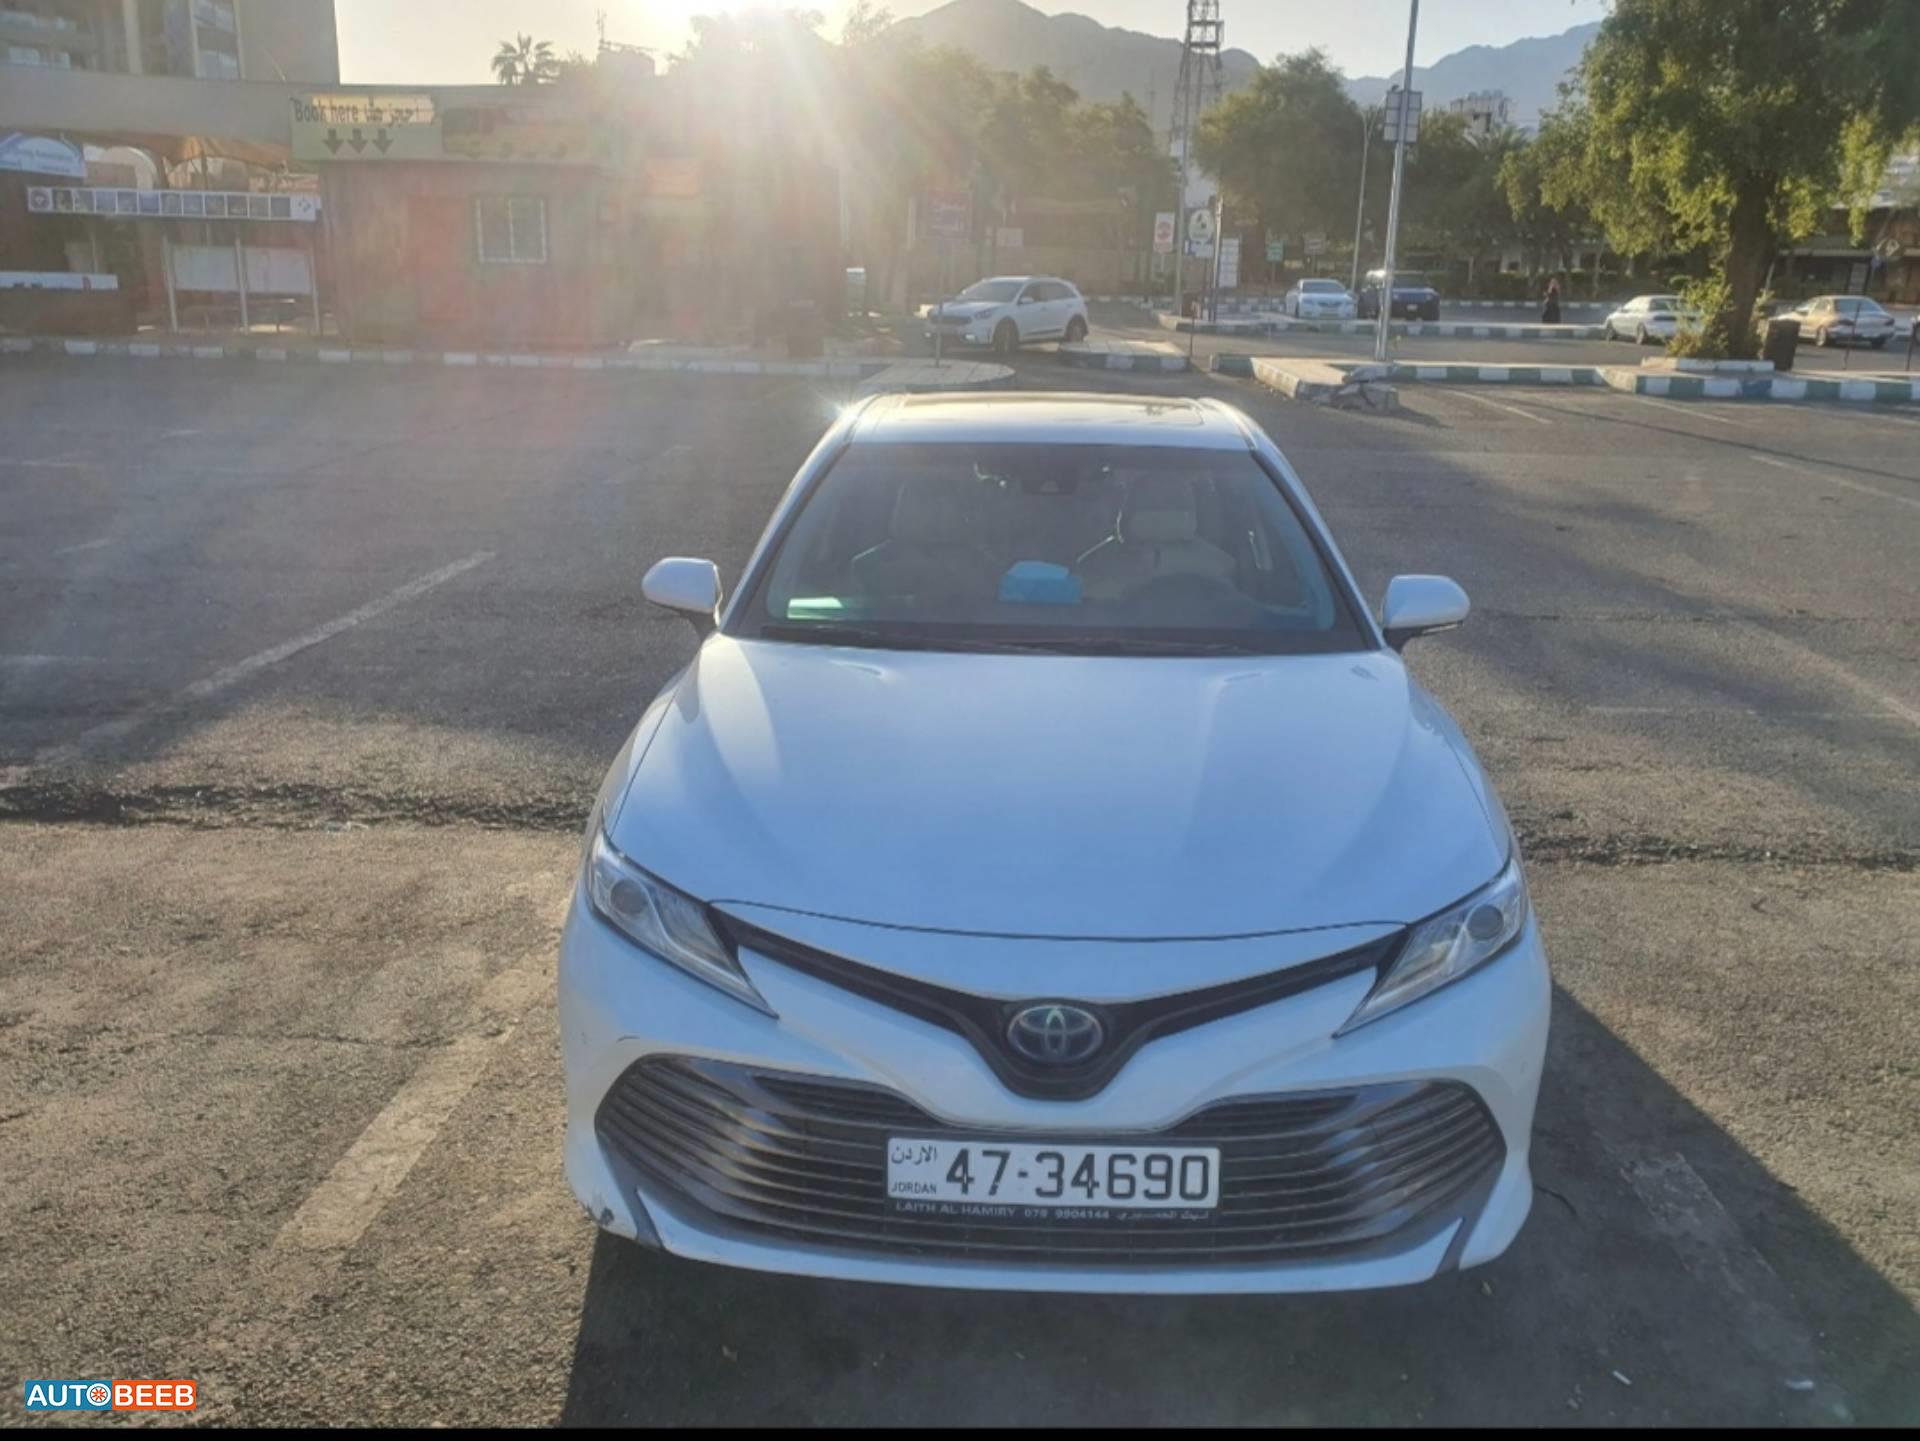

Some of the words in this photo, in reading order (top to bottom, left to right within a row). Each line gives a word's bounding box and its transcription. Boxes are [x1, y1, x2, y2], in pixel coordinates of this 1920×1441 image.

[291, 98, 327, 122] Book
[330, 99, 358, 122] here
[946, 1148, 1209, 1200] 47-34690
[891, 1182, 937, 1195] JORDAN
[896, 1200, 935, 1213] LAITH
[940, 1203, 958, 1214] AL
